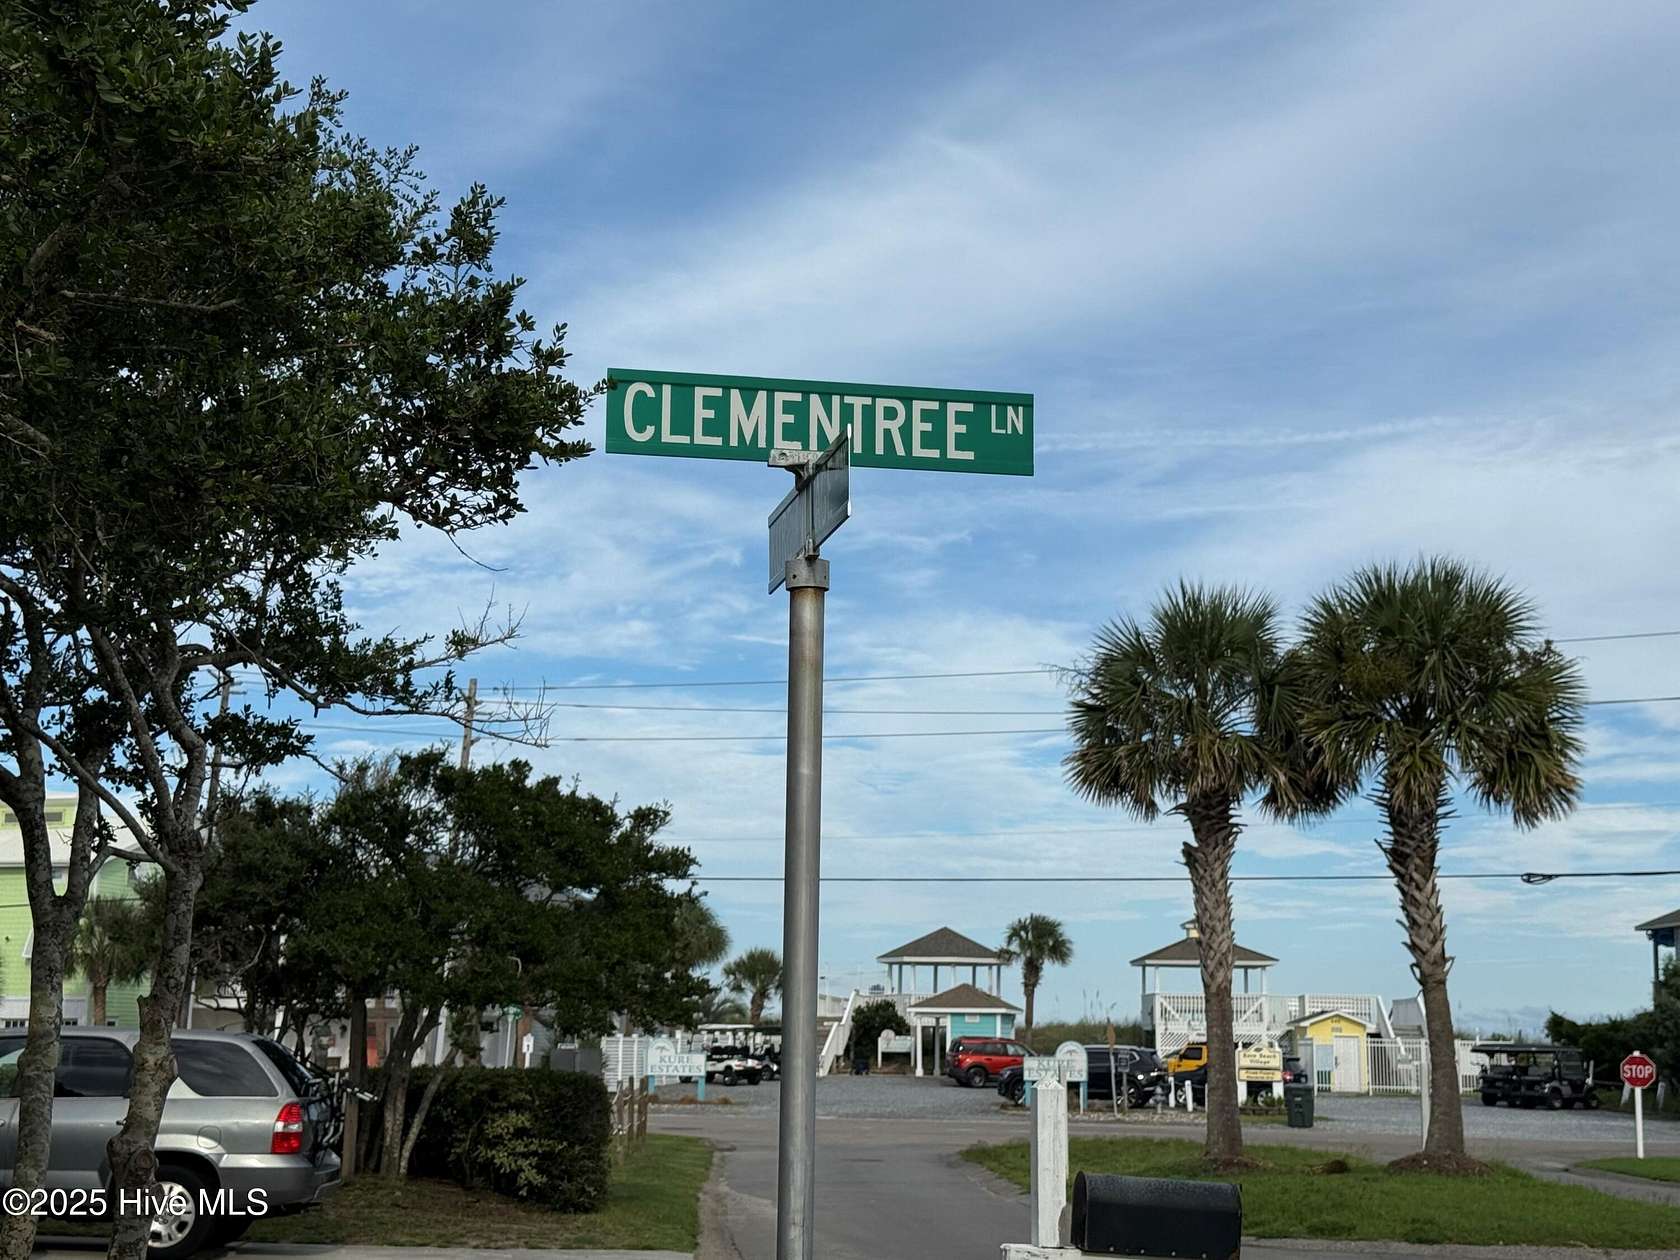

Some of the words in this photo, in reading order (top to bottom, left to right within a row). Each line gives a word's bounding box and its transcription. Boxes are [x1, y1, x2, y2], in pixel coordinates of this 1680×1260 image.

[623, 382, 975, 461] CLEMENTREE
[991, 404, 1024, 435] LN
[650, 1064, 702, 1073] ESTATES
[1027, 1069, 1084, 1079] ESTAES
[1623, 1065, 1653, 1078] STOP
